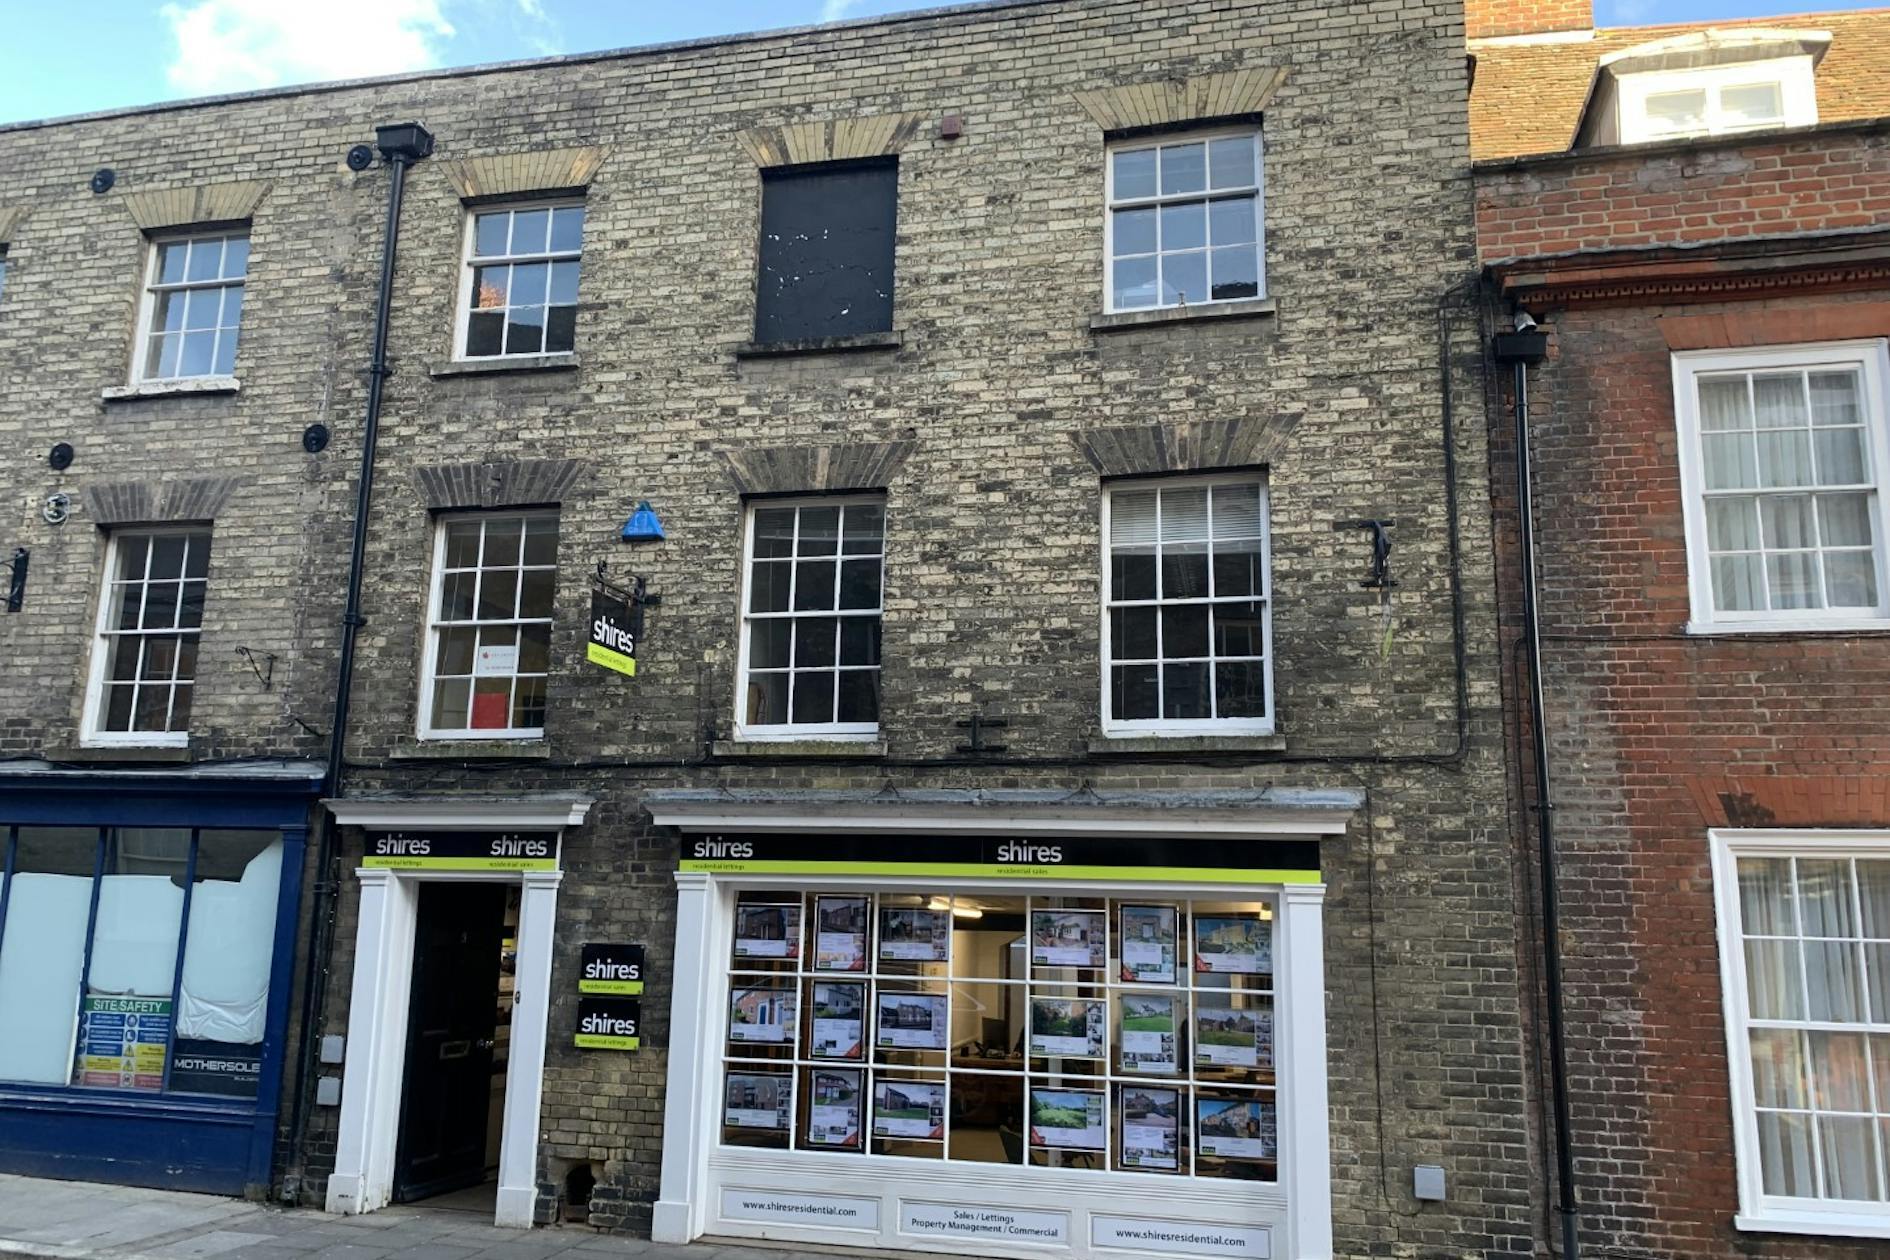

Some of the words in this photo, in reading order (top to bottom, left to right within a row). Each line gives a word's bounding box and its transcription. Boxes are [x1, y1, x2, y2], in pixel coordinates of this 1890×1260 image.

[593, 615, 634, 653] shires
[376, 833, 431, 855] shires
[490, 835, 548, 856] shires
[694, 836, 753, 858] shires
[997, 840, 1063, 862] shires
[585, 958, 639, 979] shires
[93, 999, 117, 1011] SITE
[119, 1000, 163, 1013] SAFETY
[581, 1013, 636, 1035] shires
[174, 1058, 261, 1073] MOTHERSOLE
[743, 1201, 857, 1217] www.shiresresidential.com
[953, 1210, 975, 1220] Sales
[981, 1213, 1014, 1225] Lettings
[911, 1218, 946, 1230] Property
[949, 1221, 1002, 1233] Management
[1008, 1226, 1058, 1237] Commercial
[1116, 1229, 1245, 1247] www.shiresresidential.com
